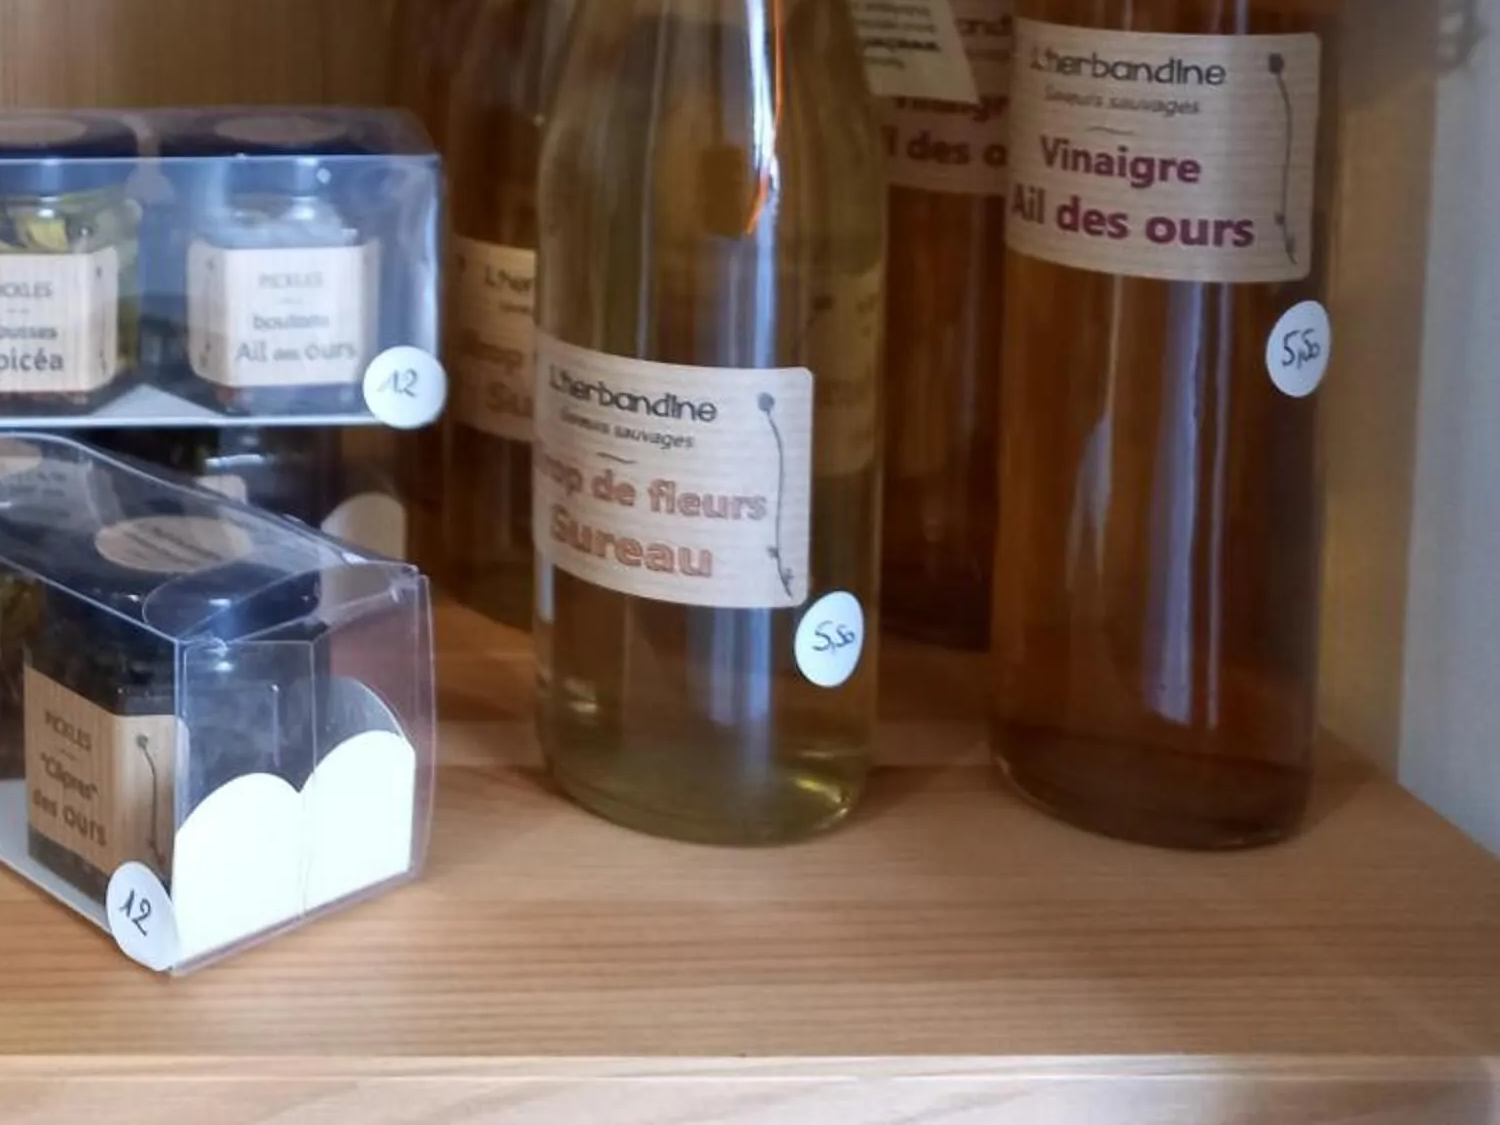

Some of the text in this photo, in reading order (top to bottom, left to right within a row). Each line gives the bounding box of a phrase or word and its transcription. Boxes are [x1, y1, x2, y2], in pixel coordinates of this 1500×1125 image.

[1040, 134, 1201, 189] Vinaigre
[1011, 183, 1255, 248] Ail des ours
[377, 368, 419, 399] 12
[591, 468, 636, 507] de
[649, 477, 768, 521] fleurs
[551, 504, 713, 578] Sureau
[119, 890, 153, 937] 12
